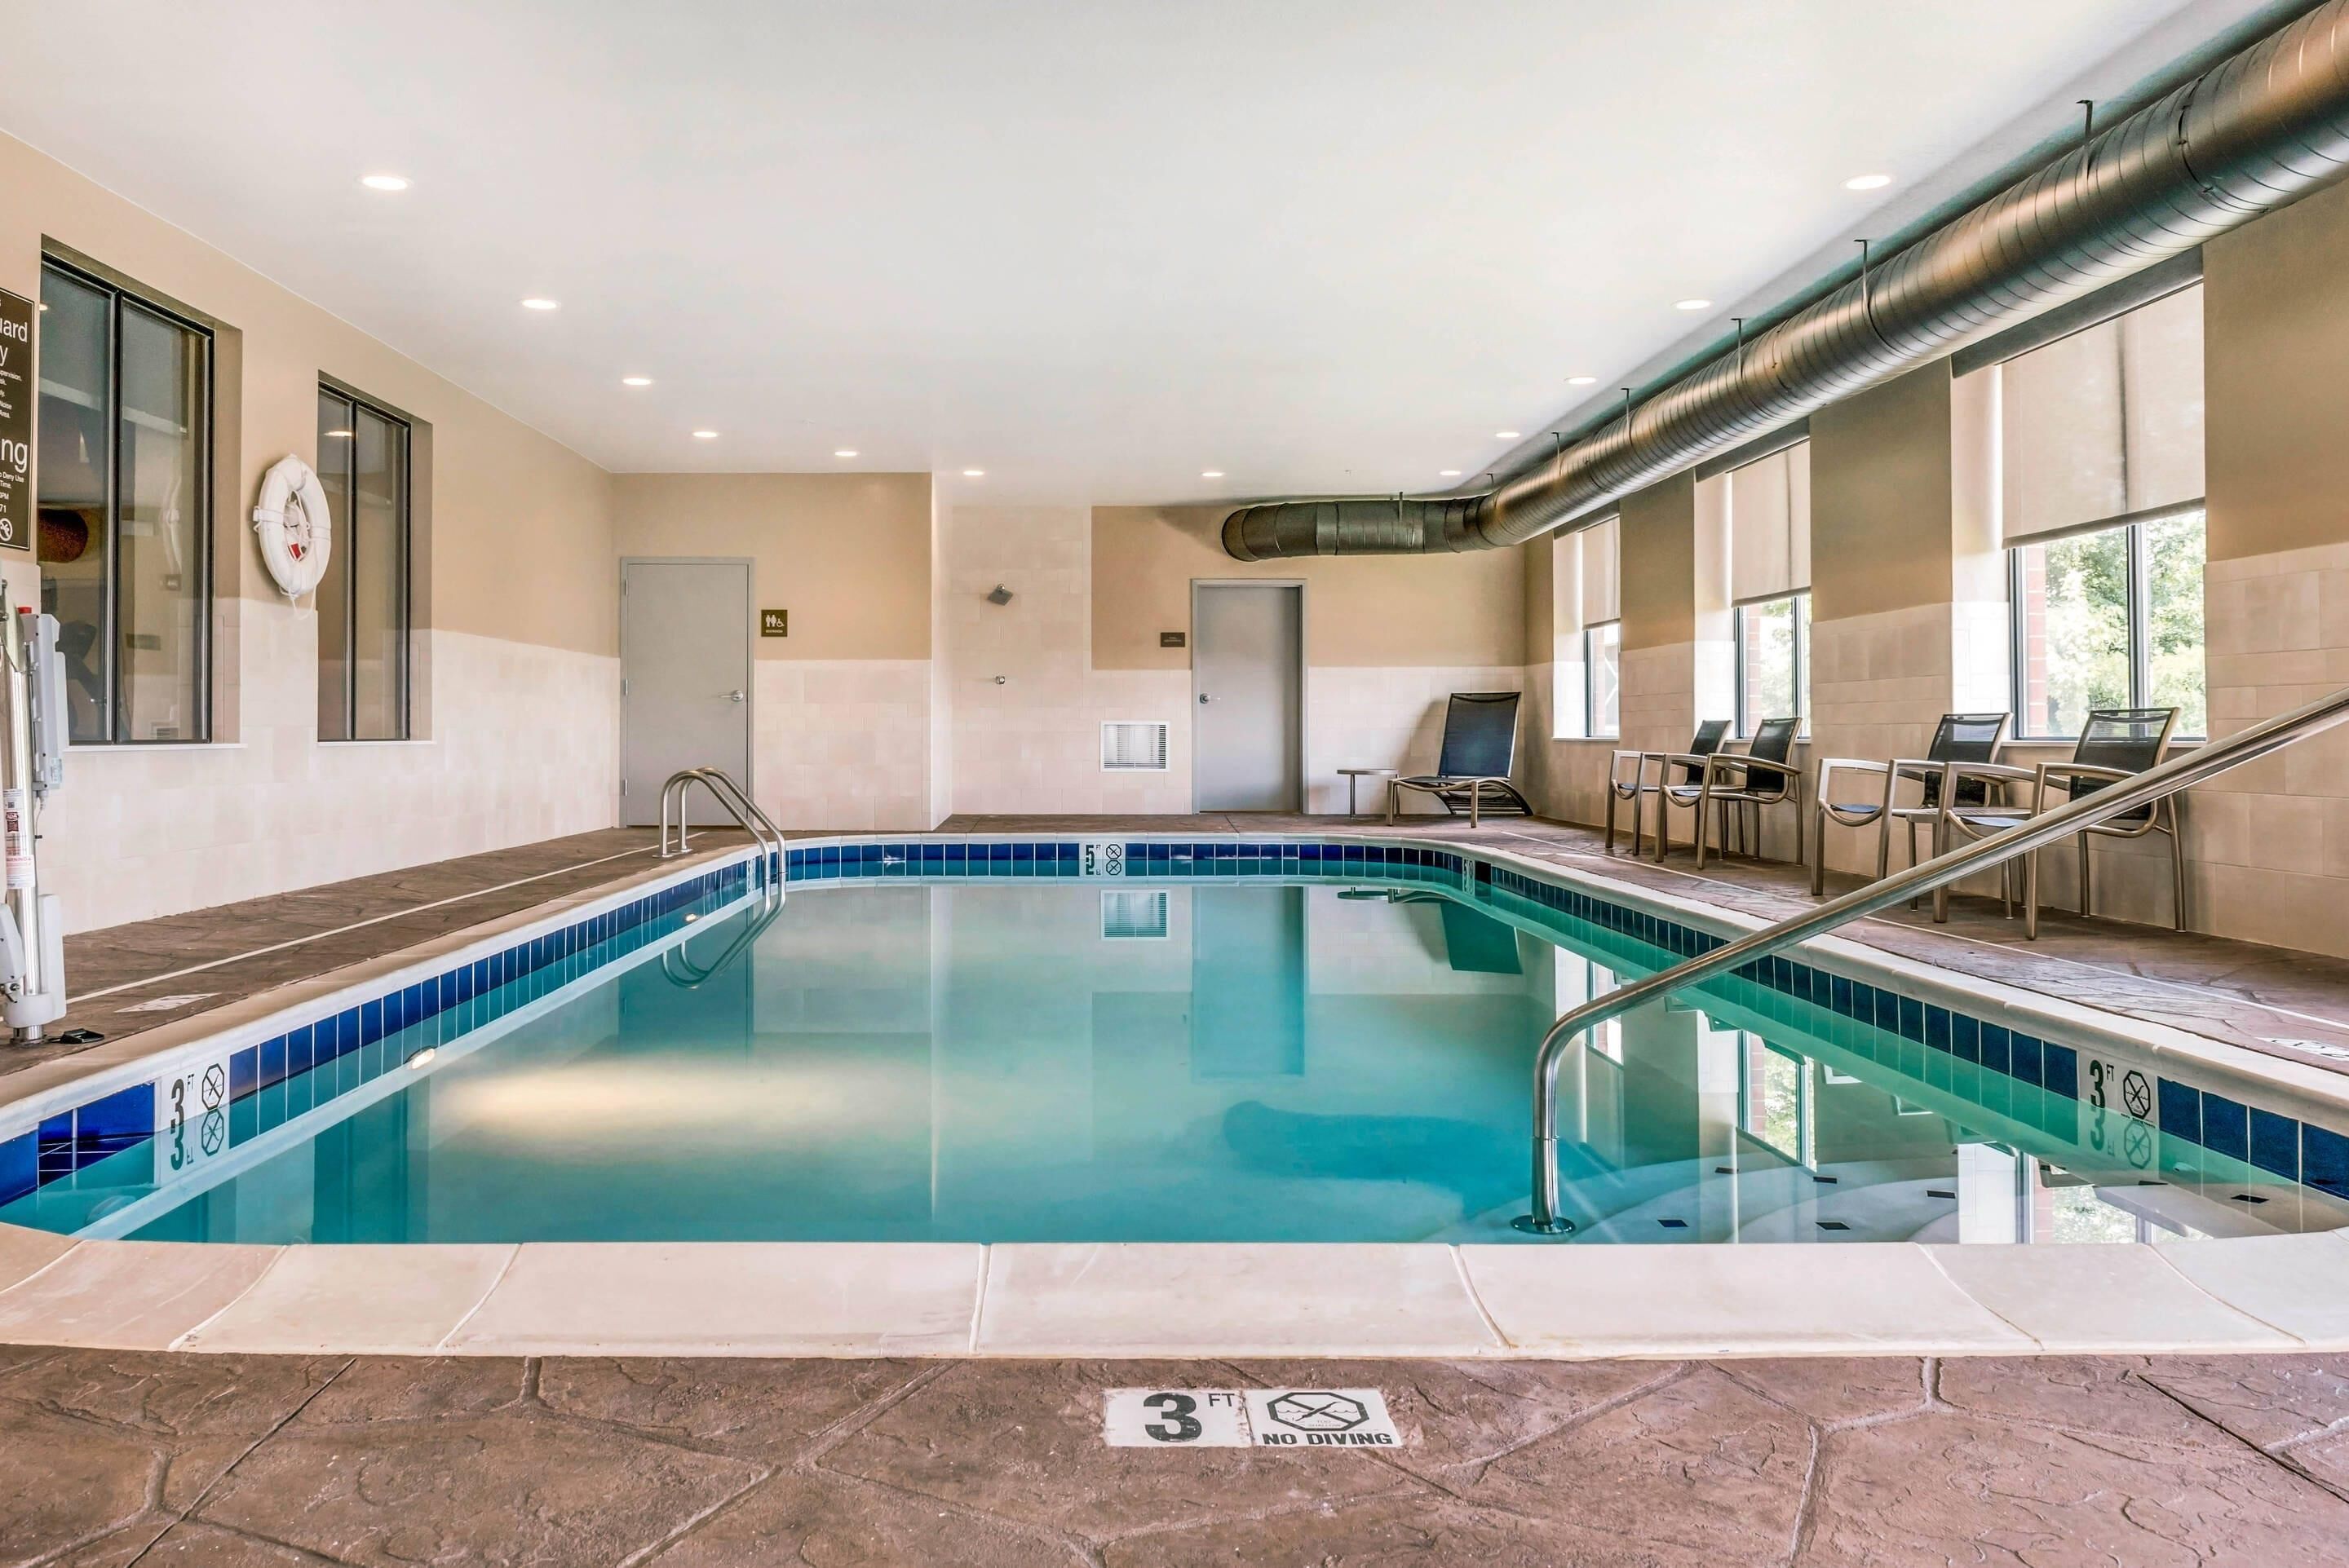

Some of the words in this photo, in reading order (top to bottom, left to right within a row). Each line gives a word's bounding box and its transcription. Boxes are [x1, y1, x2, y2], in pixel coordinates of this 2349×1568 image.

[1086, 844, 1095, 861] 5
[170, 1078, 184, 1129] 3
[187, 1073, 195, 1092] FT
[2090, 1059, 2105, 1109] 3
[2106, 1063, 2114, 1082] FT
[1143, 1392, 1202, 1442] 3
[1208, 1393, 1235, 1407] FT
[1262, 1433, 1298, 1445] NO
[1306, 1433, 1393, 1445] DIVING
